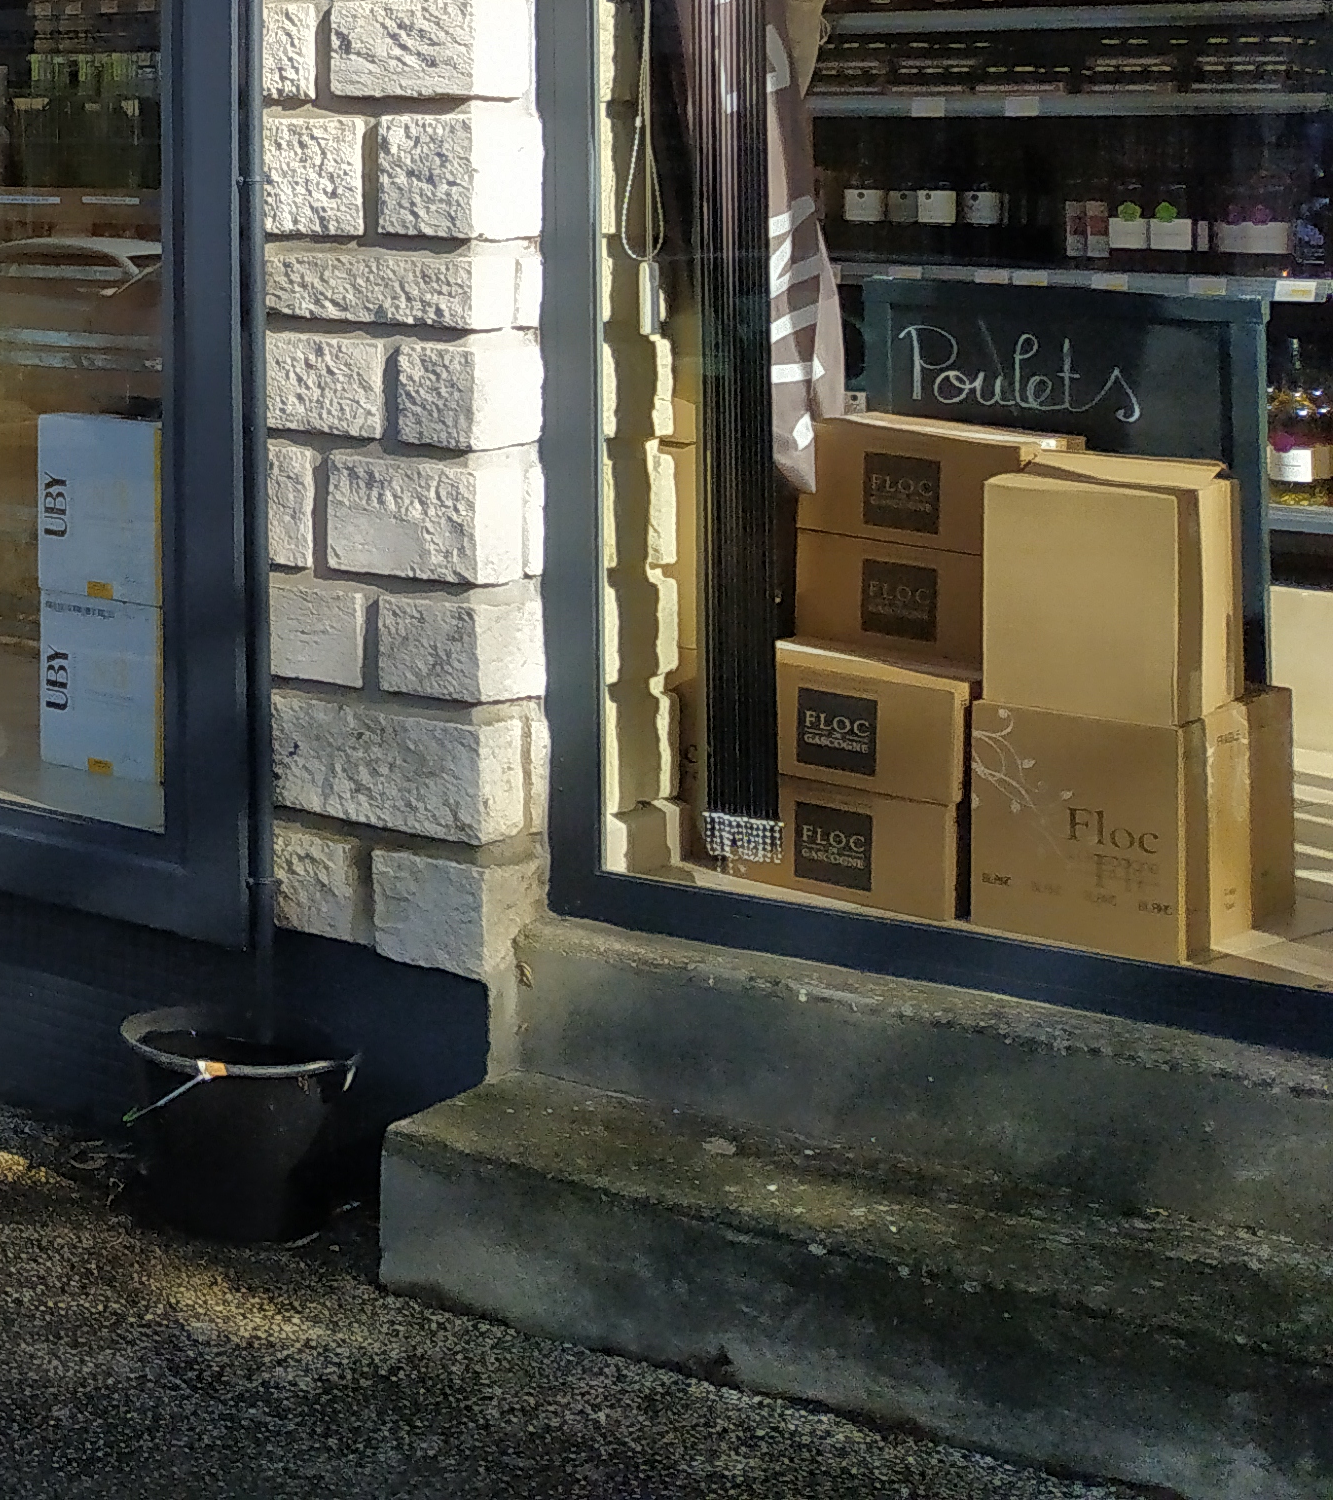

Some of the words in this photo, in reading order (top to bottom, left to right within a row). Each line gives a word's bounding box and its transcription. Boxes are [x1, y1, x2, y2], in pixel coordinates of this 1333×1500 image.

[898, 324, 1141, 423] Poulets
[870, 473, 933, 497] FLOC
[44, 470, 68, 538] UBY
[868, 581, 931, 604] FLOC
[45, 644, 70, 712] UBY
[804, 710, 870, 737] FLOC
[804, 733, 869, 754] GASCOGNE
[802, 825, 866, 852] FLOC
[1067, 806, 1159, 855] Floc
[801, 849, 866, 870] GASCOGNE
